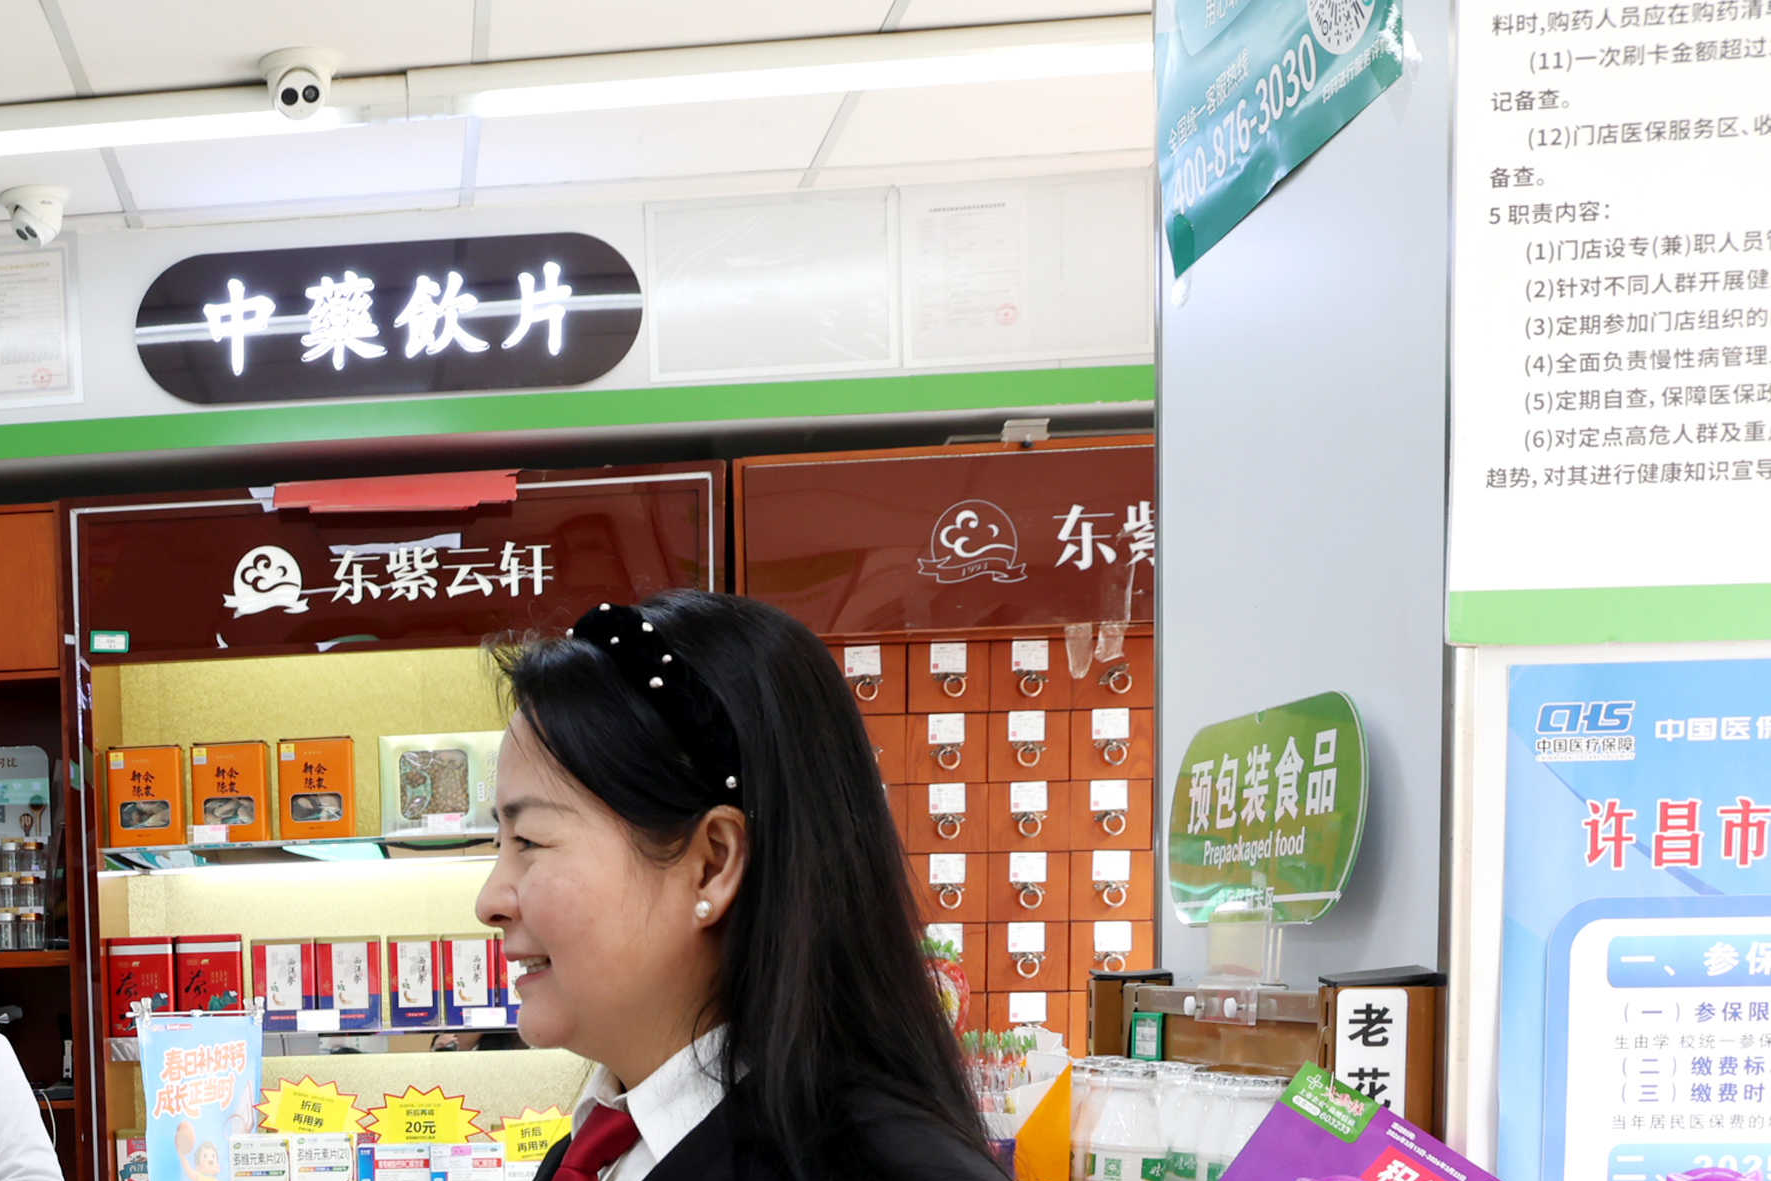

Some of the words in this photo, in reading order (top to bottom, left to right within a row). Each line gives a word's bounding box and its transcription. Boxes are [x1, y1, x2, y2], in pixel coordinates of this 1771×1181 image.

[1492, 0, 1771, 38] 料时,购药人员应在购药清
[1529, 36, 1771, 74] (11)一次刷卡金额超过
[1491, 88, 1570, 113] 记备查。
[1173, 33, 1317, 215] 400-876-3030
[1489, 165, 1545, 189] 备查。
[1489, 206, 1502, 225] 5
[1525, 229, 1771, 265] (1)门店设专(兼)职人员
[1524, 420, 1771, 452] (6)对定点高危人群及重
[329, 540, 554, 605] 东紫云轩
[1536, 736, 1634, 753] 中国医疗保障
[1186, 727, 1339, 836] 预包装食品
[1202, 832, 1273, 869] Prepackaged
[1273, 826, 1306, 857] food
[1584, 798, 1771, 869] 许昌市
[161, 1040, 247, 1082] 春日补好钙
[154, 1074, 236, 1119] 成长正当时
[404, 1120, 437, 1135] 20元
[1612, 1112, 1771, 1131] 当年居民医保费的
